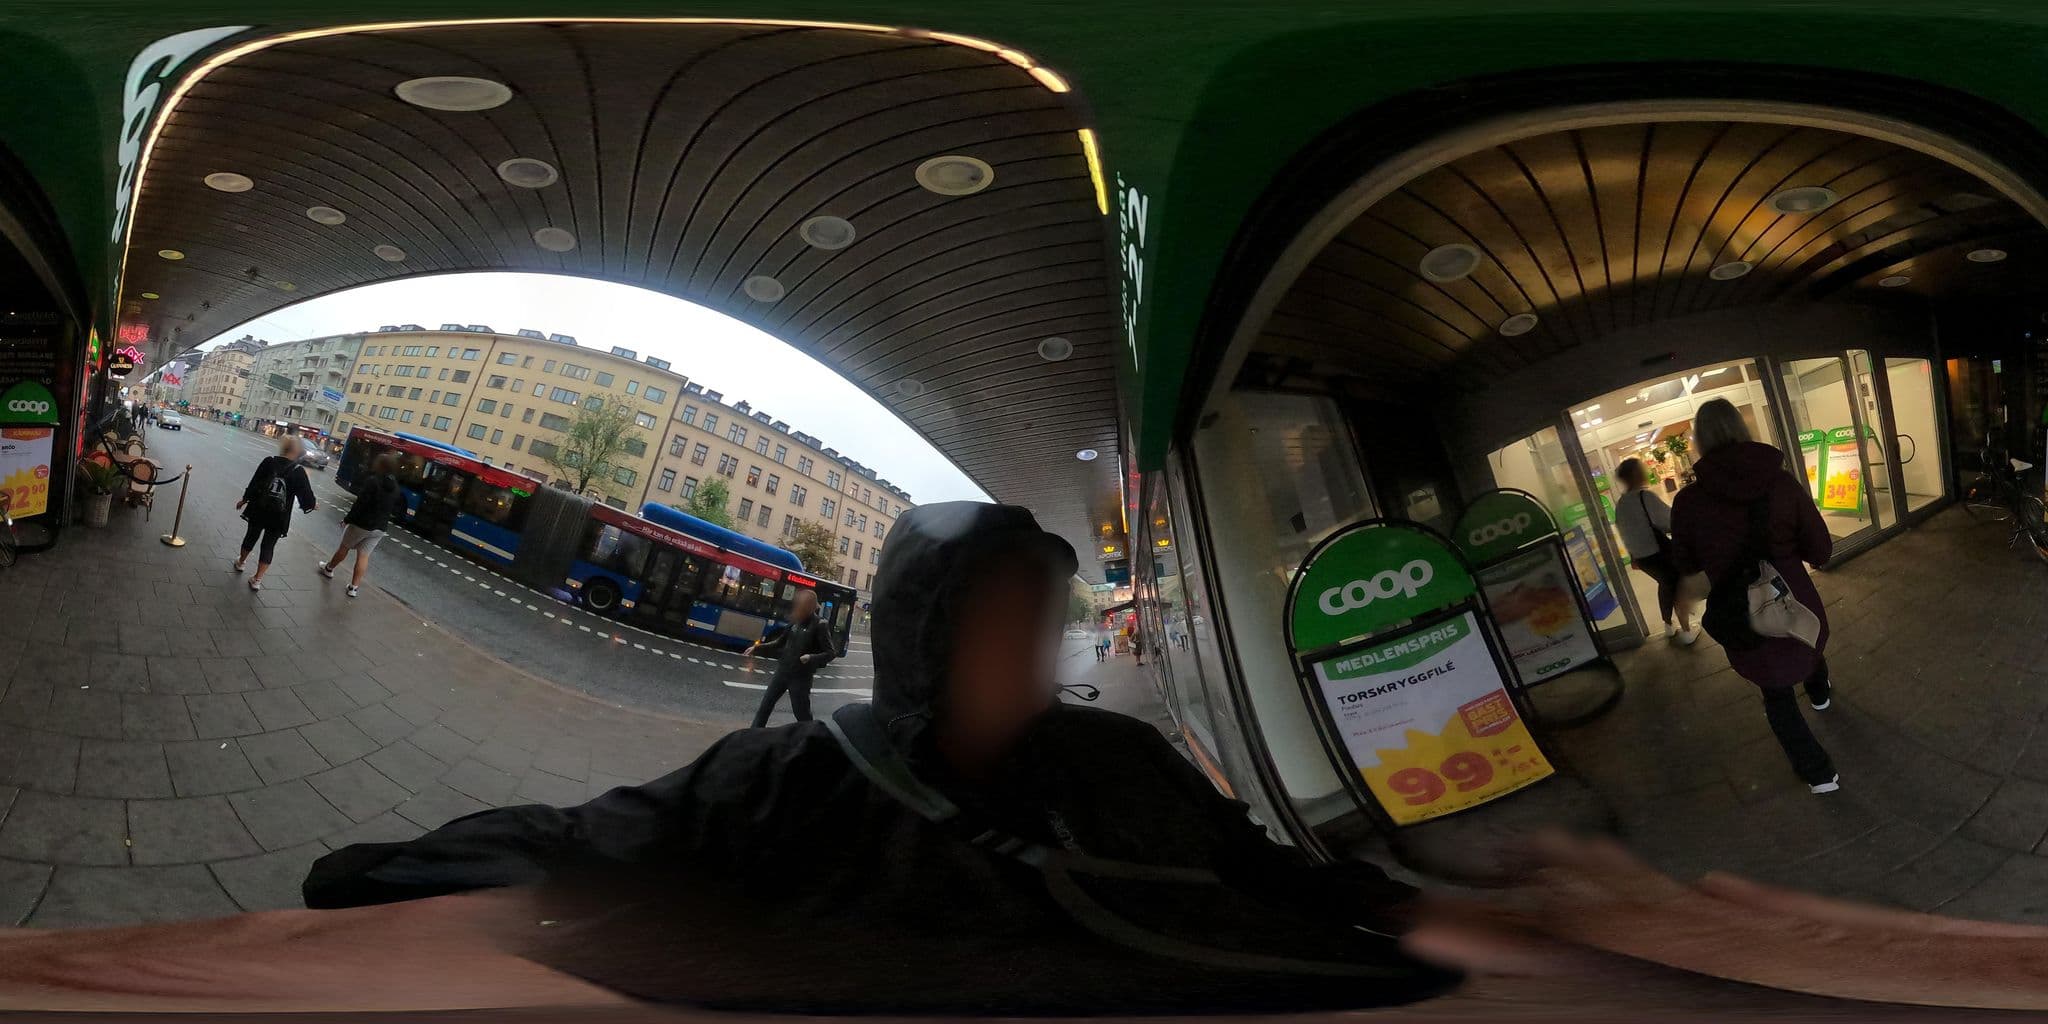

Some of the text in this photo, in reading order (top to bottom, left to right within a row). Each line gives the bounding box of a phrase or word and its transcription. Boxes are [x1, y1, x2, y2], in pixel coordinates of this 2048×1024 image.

[8, 399, 49, 415] coop
[1468, 512, 1530, 546] coop
[1318, 559, 1433, 616] coop
[1335, 624, 1458, 674] MEDLEMSPRIS
[1536, 657, 1571, 675] coop
[1337, 659, 1456, 705] TORSKRYGGFILÉ
